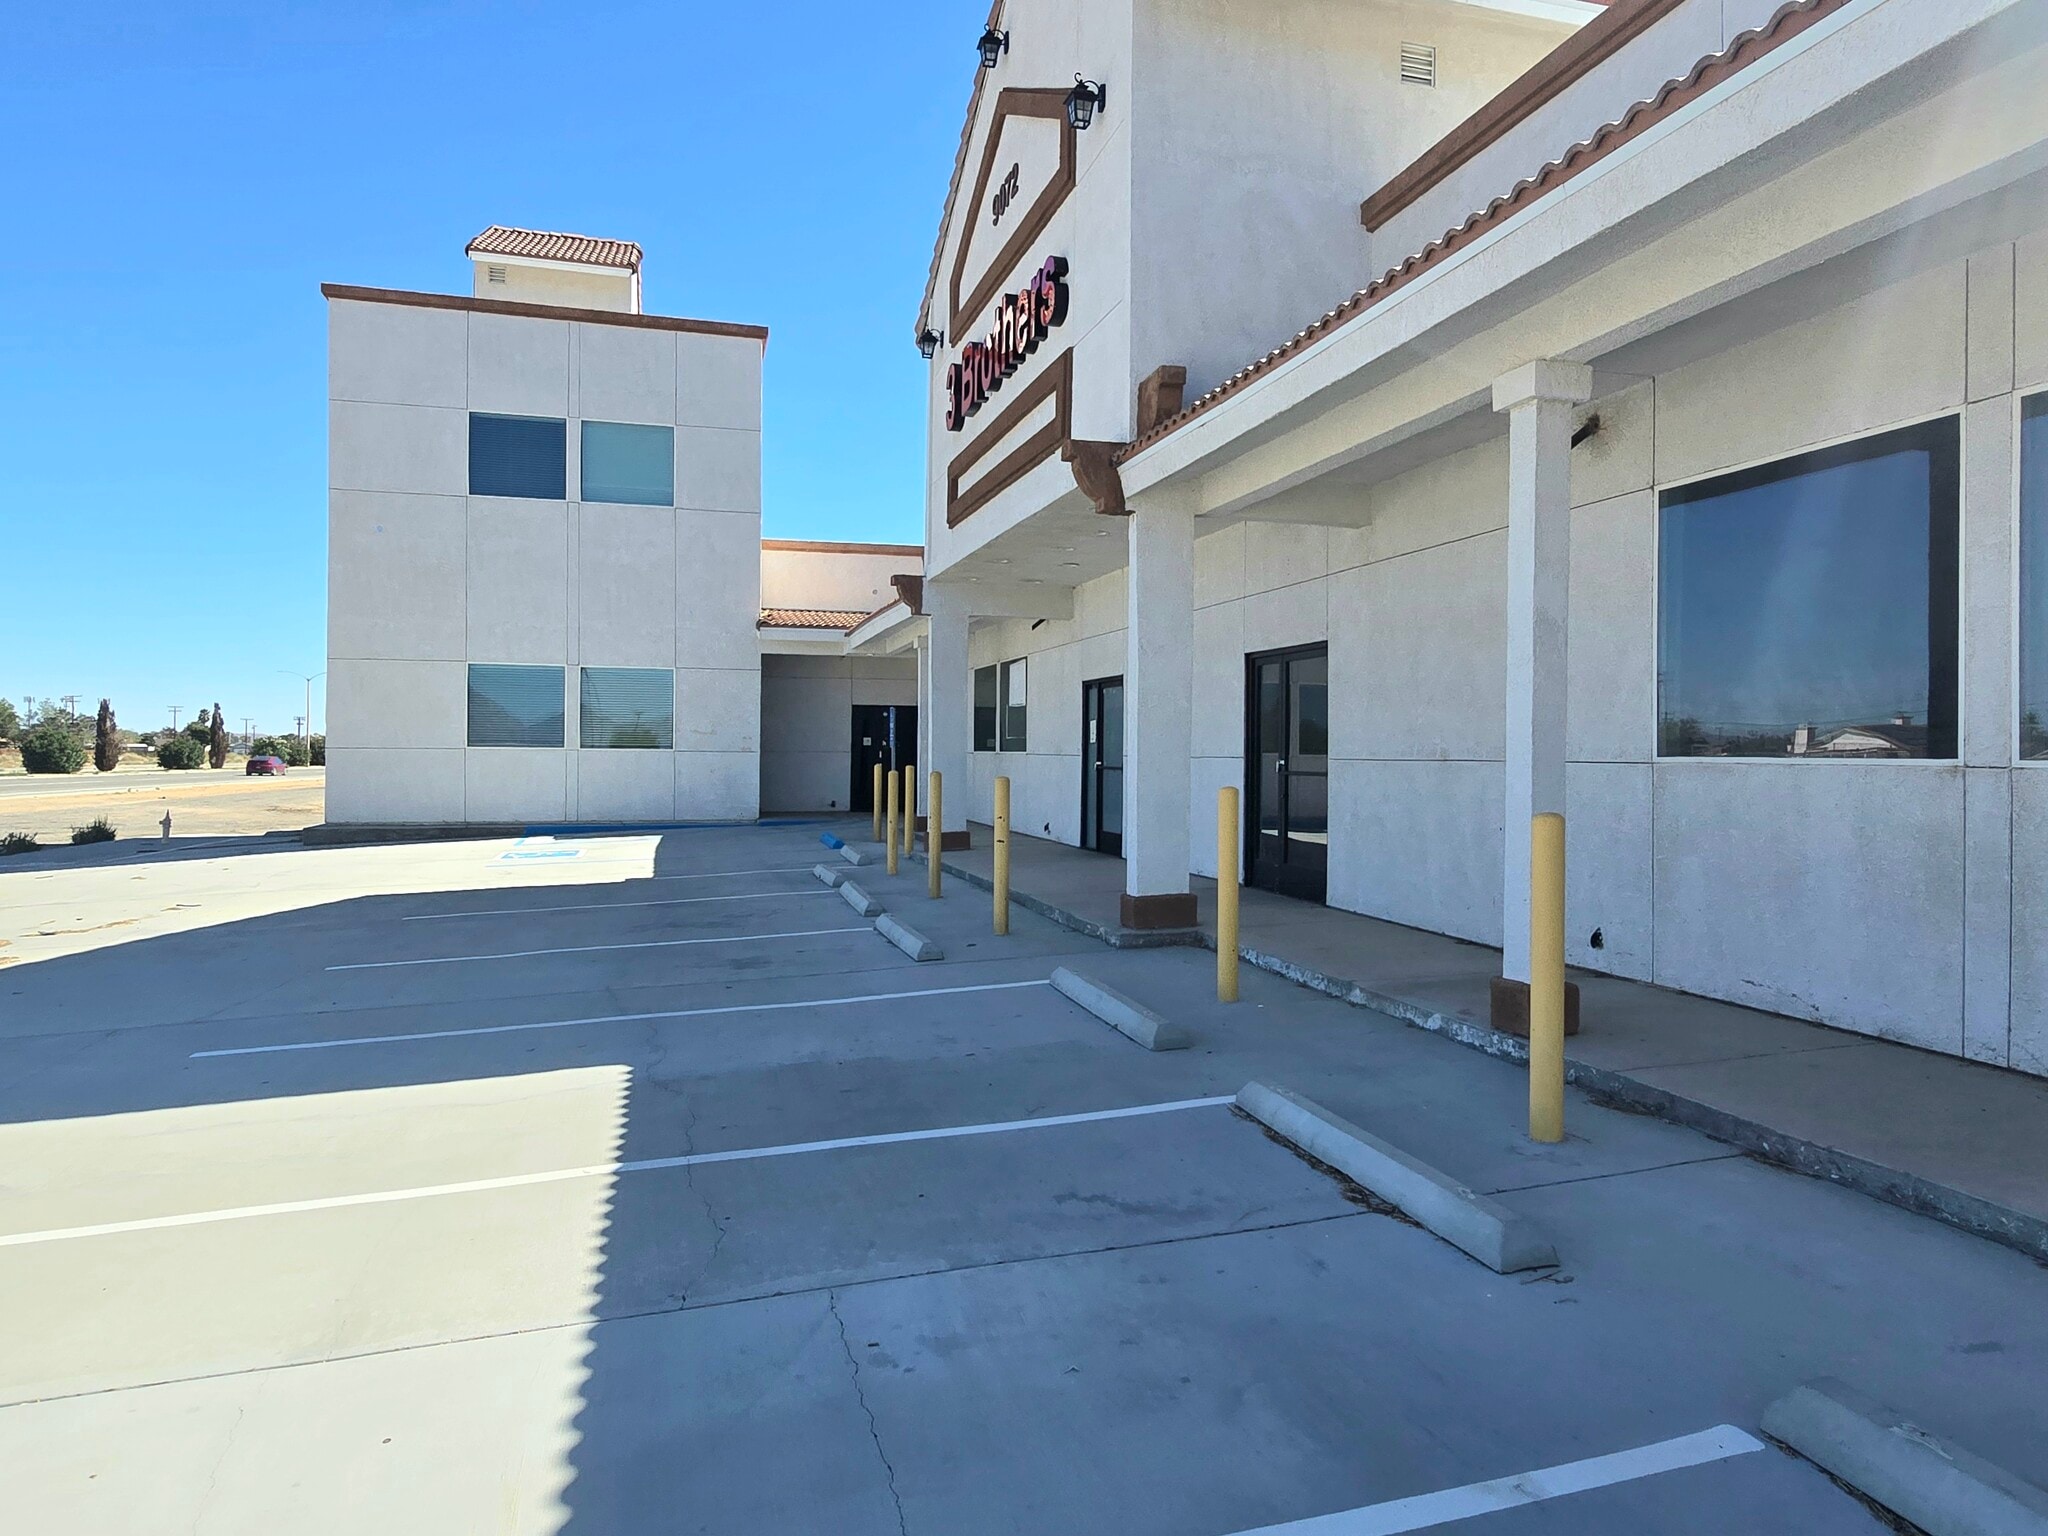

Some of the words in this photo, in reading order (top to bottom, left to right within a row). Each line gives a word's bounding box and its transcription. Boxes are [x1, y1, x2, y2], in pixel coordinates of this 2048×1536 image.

[993, 163, 1019, 226] 9072
[946, 363, 964, 432] 3
[961, 255, 1068, 417] Brothers
